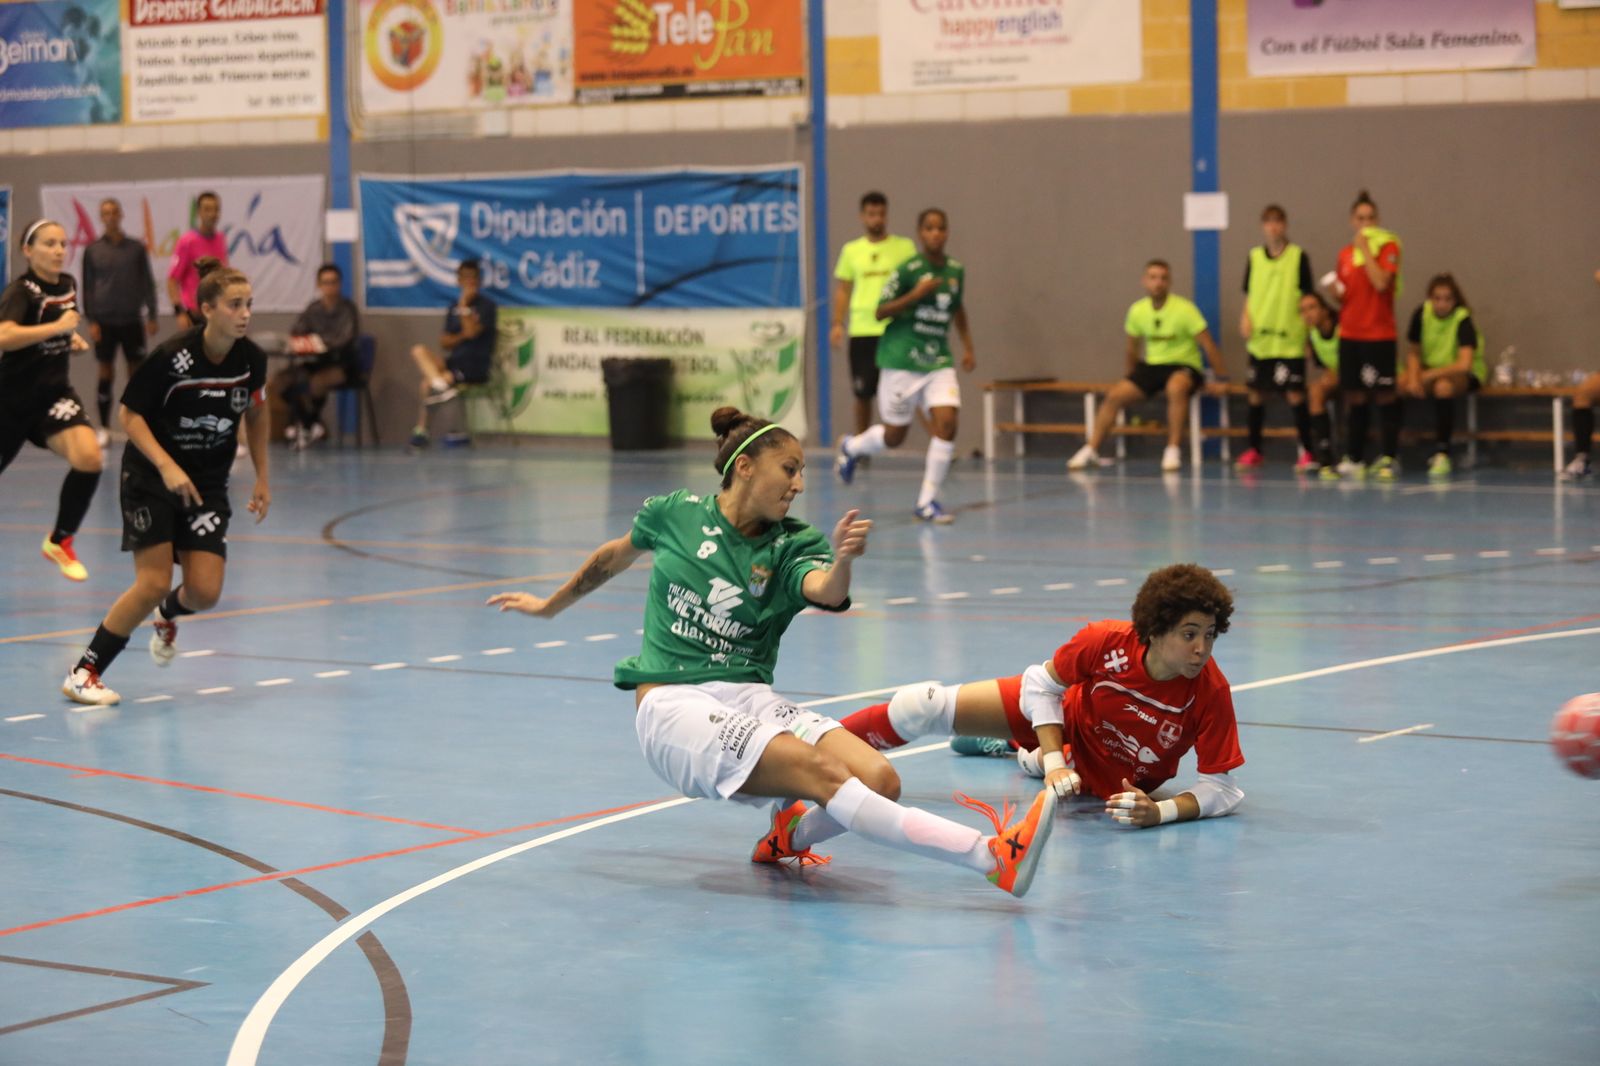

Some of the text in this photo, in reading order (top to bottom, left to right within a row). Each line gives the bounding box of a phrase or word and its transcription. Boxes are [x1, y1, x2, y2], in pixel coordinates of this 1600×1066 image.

[1261, 37, 1296, 55] Con
[1301, 37, 1317, 54] el
[1385, 32, 1425, 51] Sala
[471, 197, 799, 243] Diputación DEPORTES
[518, 248, 600, 290] Cádiz
[563, 326, 706, 347] REAL FEDERACIÓN
[696, 540, 718, 559] 8
